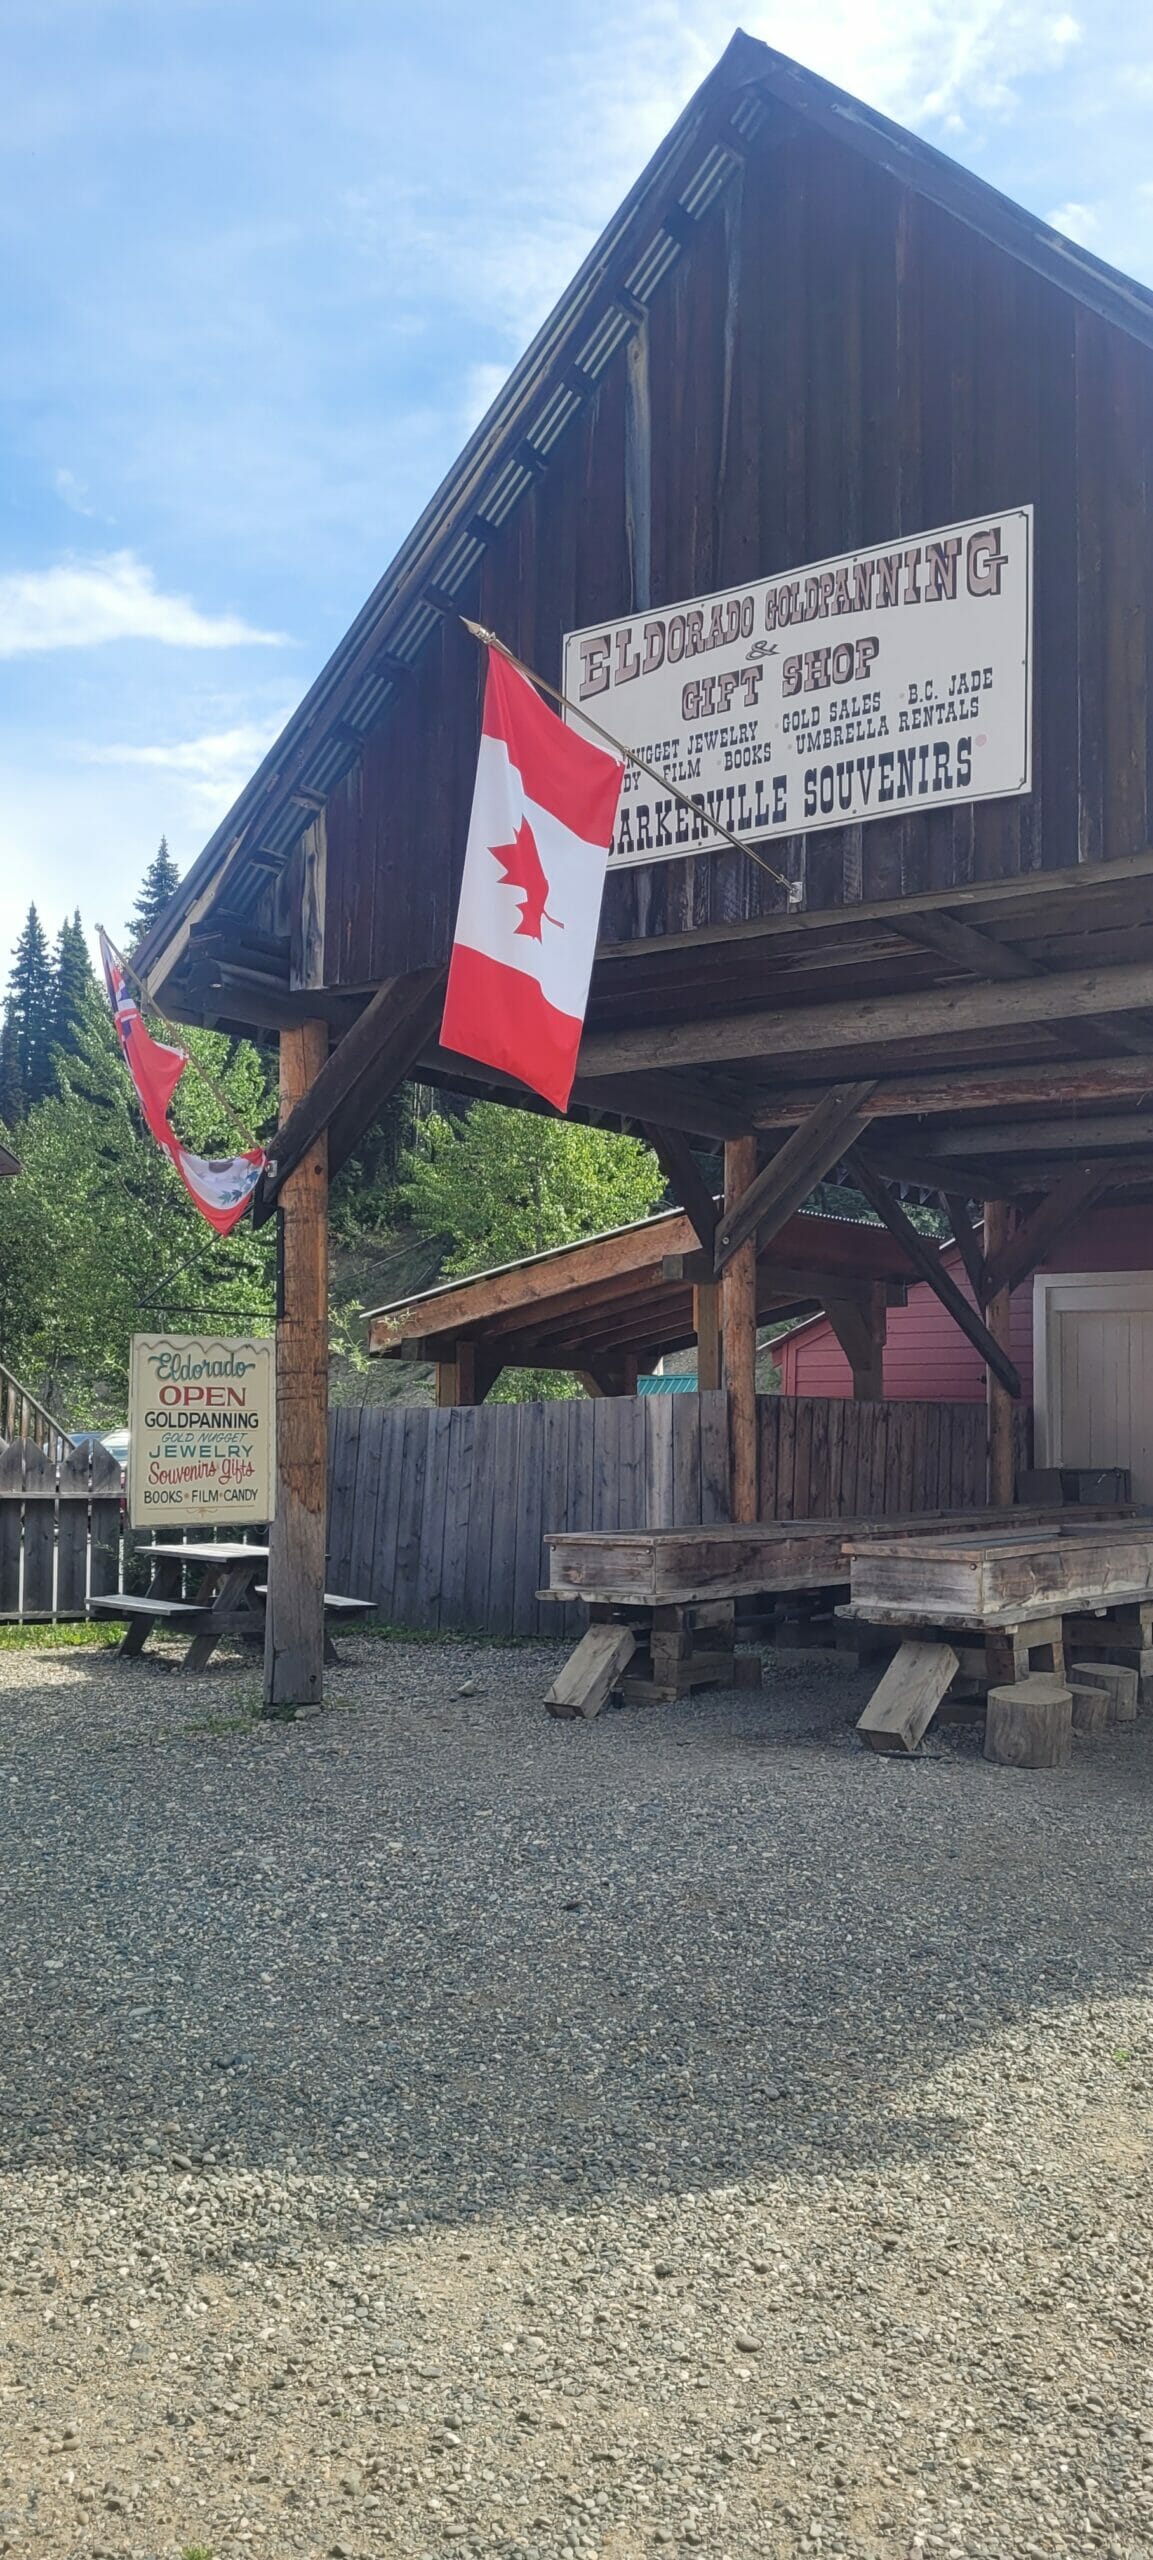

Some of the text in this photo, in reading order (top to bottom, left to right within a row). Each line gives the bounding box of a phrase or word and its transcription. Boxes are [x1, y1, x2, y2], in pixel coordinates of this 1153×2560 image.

[579, 527, 1008, 701] ELDORADO GOLDPANNING
[746, 640, 781, 660] &
[682, 636, 879, 721] GIFT SHOP
[688, 721, 758, 755] JEWELRY
[782, 707, 820, 733] GOLD
[829, 691, 881, 720] SALES
[908, 679, 938, 705] B.C.
[948, 667, 993, 695] JADE
[663, 757, 700, 783] FILM
[724, 742, 771, 771] BOOKS
[796, 715, 889, 754] UMBRELLA
[898, 697, 979, 732] RENTALS
[608, 736, 973, 857] ARKERVILLE SOUVENIRS
[148, 1353, 256, 1382] Eldorado
[159, 1386, 246, 1407] OPEN
[145, 1412, 258, 1428] GOLDPANNING
[162, 1433, 248, 1442] GOLD NUGGET
[149, 1445, 253, 1458] JEWELRY
[149, 1460, 216, 1485] Souvenirs
[144, 1489, 258, 1504] BOOKS FILM CANDY
